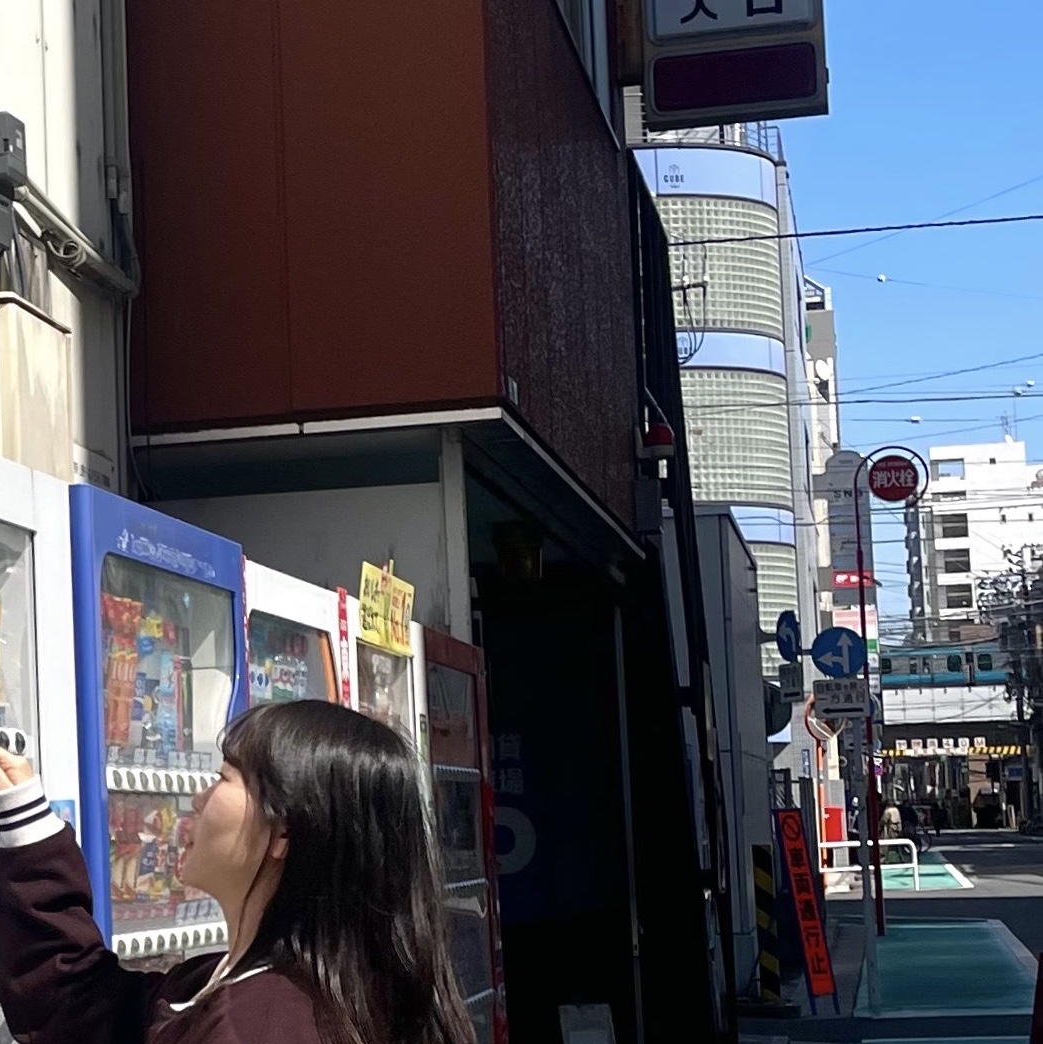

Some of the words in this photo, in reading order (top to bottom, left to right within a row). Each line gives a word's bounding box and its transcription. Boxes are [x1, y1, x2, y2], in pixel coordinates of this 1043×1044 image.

[872, 468, 915, 489] 消火栓
[817, 693, 865, 704] 一方通行
